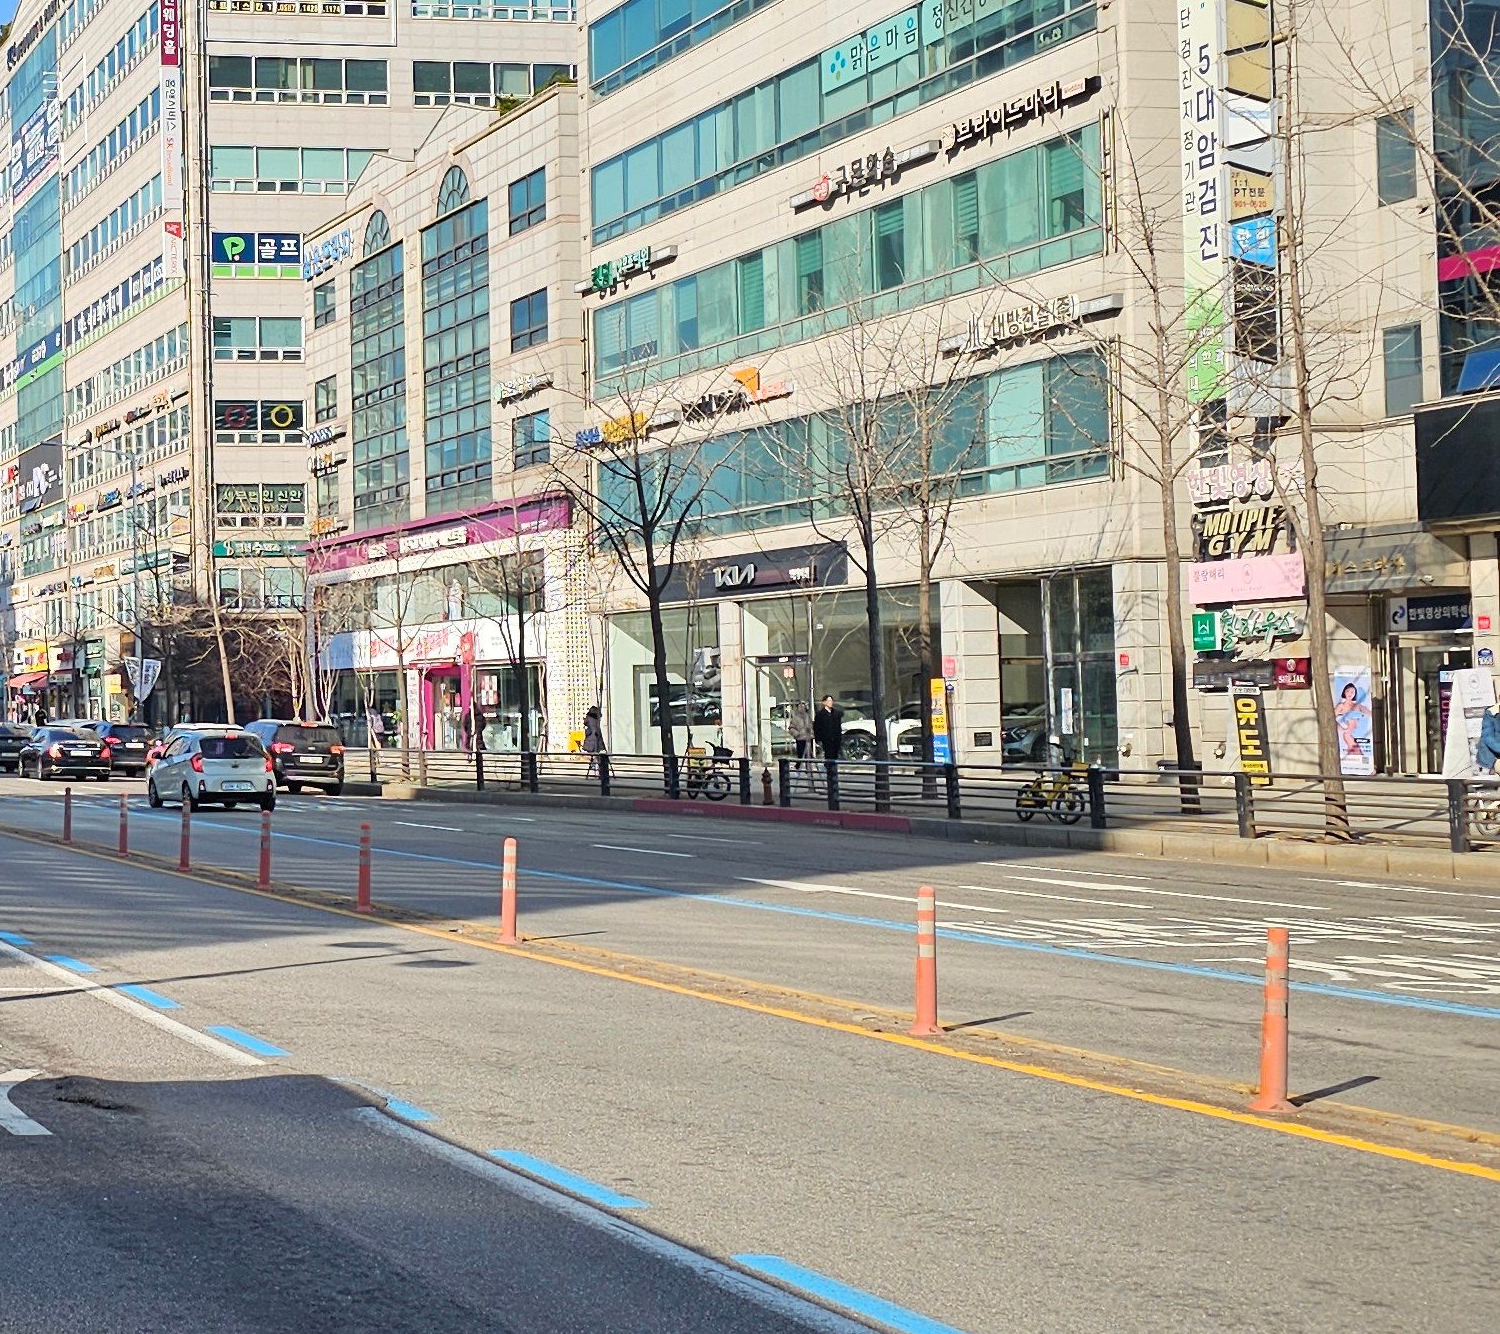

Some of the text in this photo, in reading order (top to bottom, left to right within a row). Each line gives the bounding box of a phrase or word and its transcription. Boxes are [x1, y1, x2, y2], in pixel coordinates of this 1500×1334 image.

[850, 16, 919, 71] 맑은마음
[956, 80, 1060, 143] 브라이드마리
[258, 237, 300, 260] 골프
[1202, 506, 1278, 537] MOTIPLE
[1208, 529, 1274, 556] GYM
